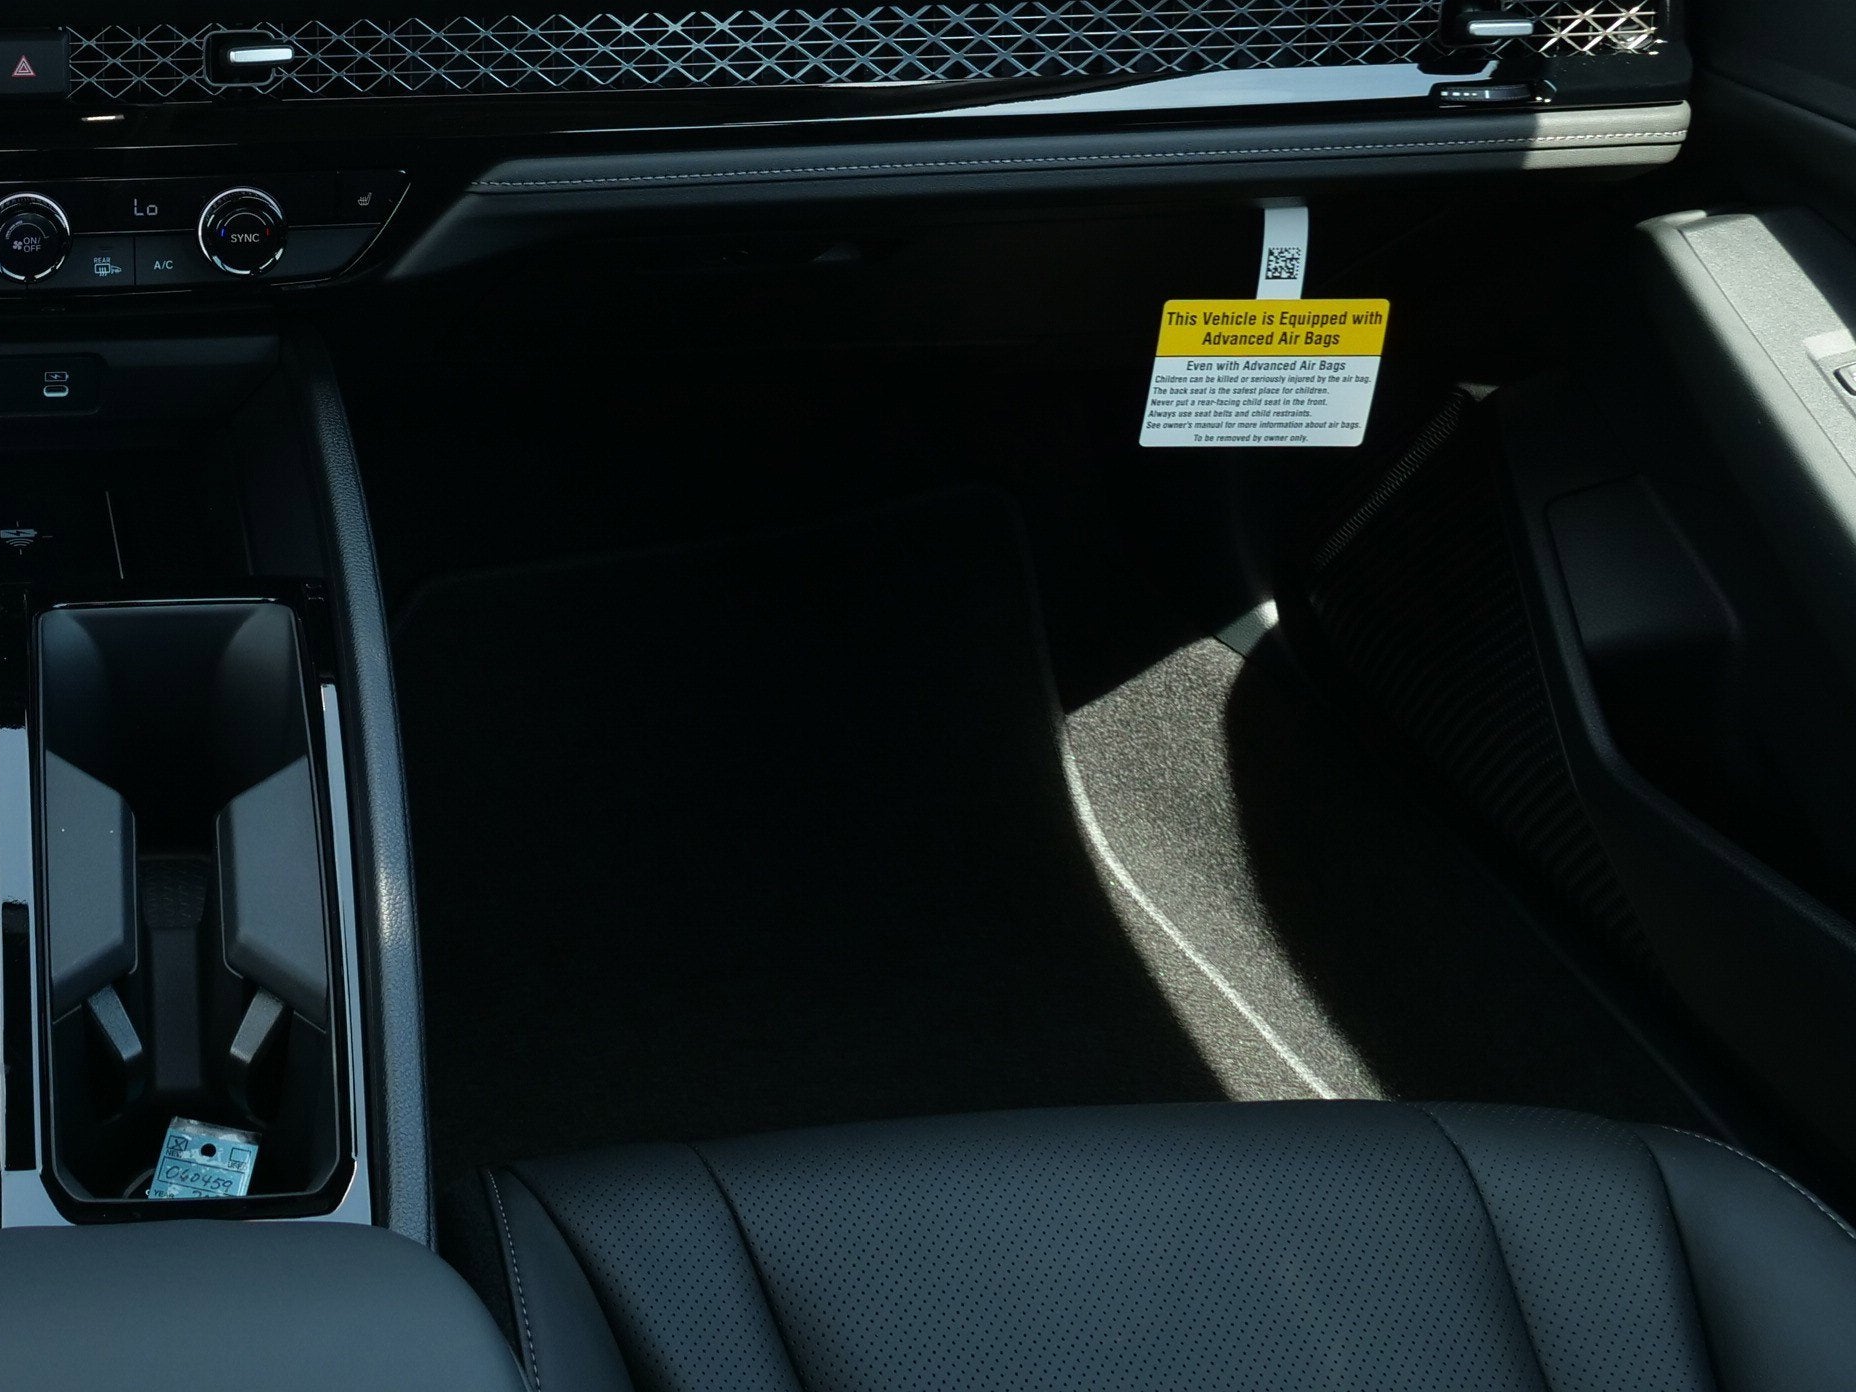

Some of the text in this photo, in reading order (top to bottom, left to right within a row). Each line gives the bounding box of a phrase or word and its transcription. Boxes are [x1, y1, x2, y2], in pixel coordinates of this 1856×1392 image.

[134, 198, 158, 216] Lo
[231, 233, 260, 243] SYNC
[153, 260, 173, 270] A/C
[1167, 311, 1382, 328] This Vehicle is Equipped with
[1202, 331, 1340, 348] Advanced Air Bags
[1187, 361, 1345, 372] Even with Advanced Air Bags
[1156, 375, 1187, 383] Children
[1205, 375, 1215, 383] be
[1217, 375, 1238, 383] killed
[1251, 375, 1285, 385] seriously
[1288, 375, 1314, 385] injured
[1317, 375, 1326, 385] by
[1329, 375, 1340, 383] the
[1342, 375, 1353, 383] air
[1355, 375, 1371, 385] bag.
[1259, 387, 1279, 396] place
[1176, 399, 1188, 408] put
[1198, 398, 1240, 408] rear-facing
[1243, 398, 1262, 406] child
[1293, 398, 1304, 406] the
[1307, 398, 1327, 406] front.
[1149, 410, 1176, 420] Always
[1195, 410, 1211, 418] seat
[1214, 410, 1232, 418] belts
[1235, 410, 1249, 418] and
[1252, 410, 1270, 418] child
[1273, 410, 1312, 418] restraints.
[1146, 421, 1161, 429] See
[1163, 421, 1192, 429] owner's
[1195, 421, 1222, 429] manual
[1225, 421, 1235, 429] for
[1259, 421, 1301, 429] information
[1304, 421, 1326, 429] about
[1329, 421, 1339, 429] air
[1341, 421, 1361, 431] bags.
[1194, 434, 1204, 442] To
[1206, 434, 1213, 442] be
[1216, 434, 1251, 442] removed
[1254, 434, 1262, 444] by
[1290, 434, 1308, 444] only.
